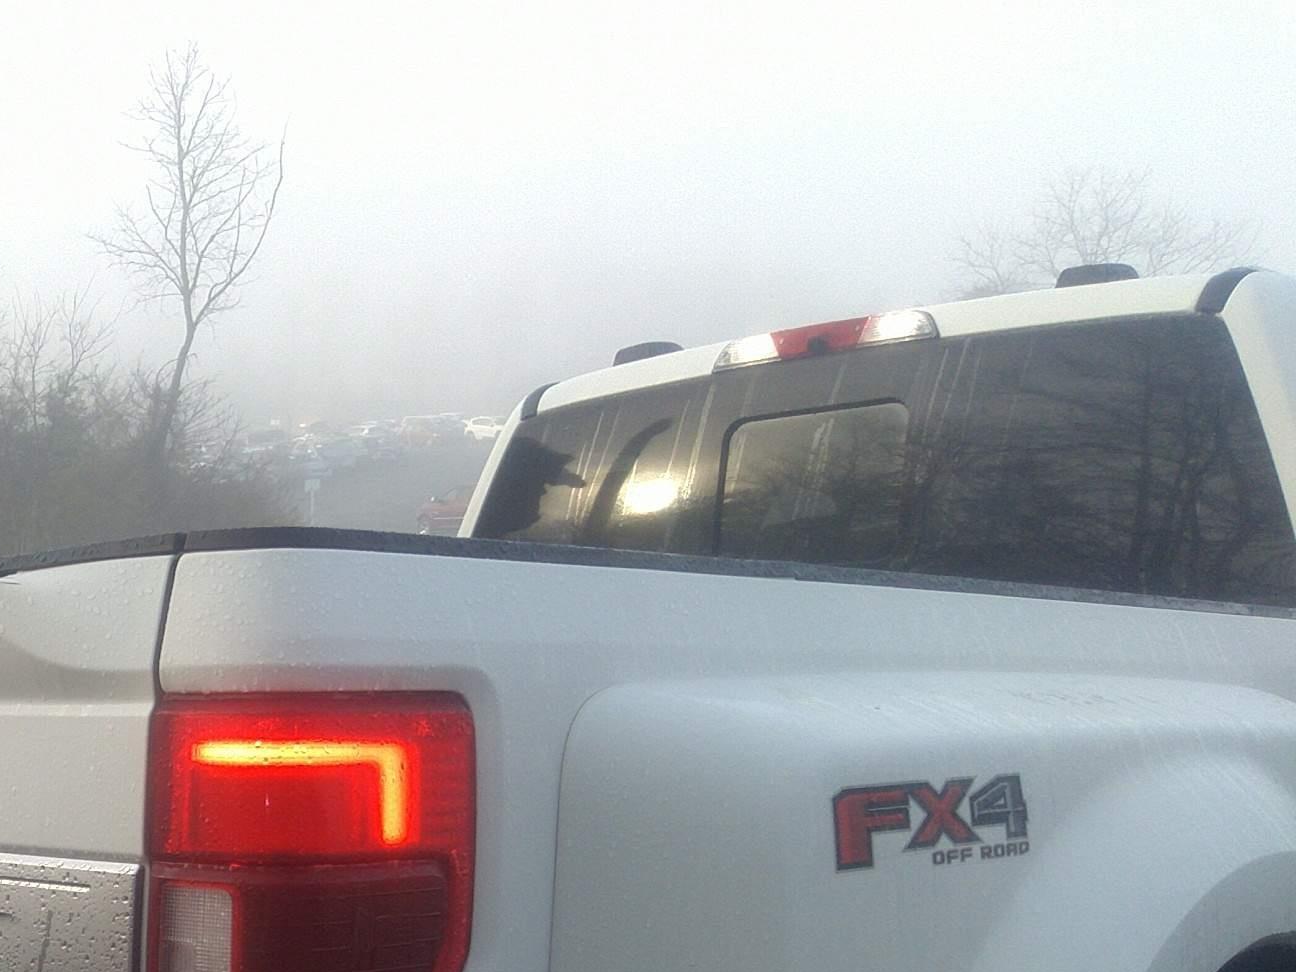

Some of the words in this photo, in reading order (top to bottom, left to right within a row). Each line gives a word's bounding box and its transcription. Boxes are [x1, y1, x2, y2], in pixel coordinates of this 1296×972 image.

[832, 772, 1029, 873] FX4
[932, 847, 973, 866] OFF
[980, 841, 1030, 860] ROAD
